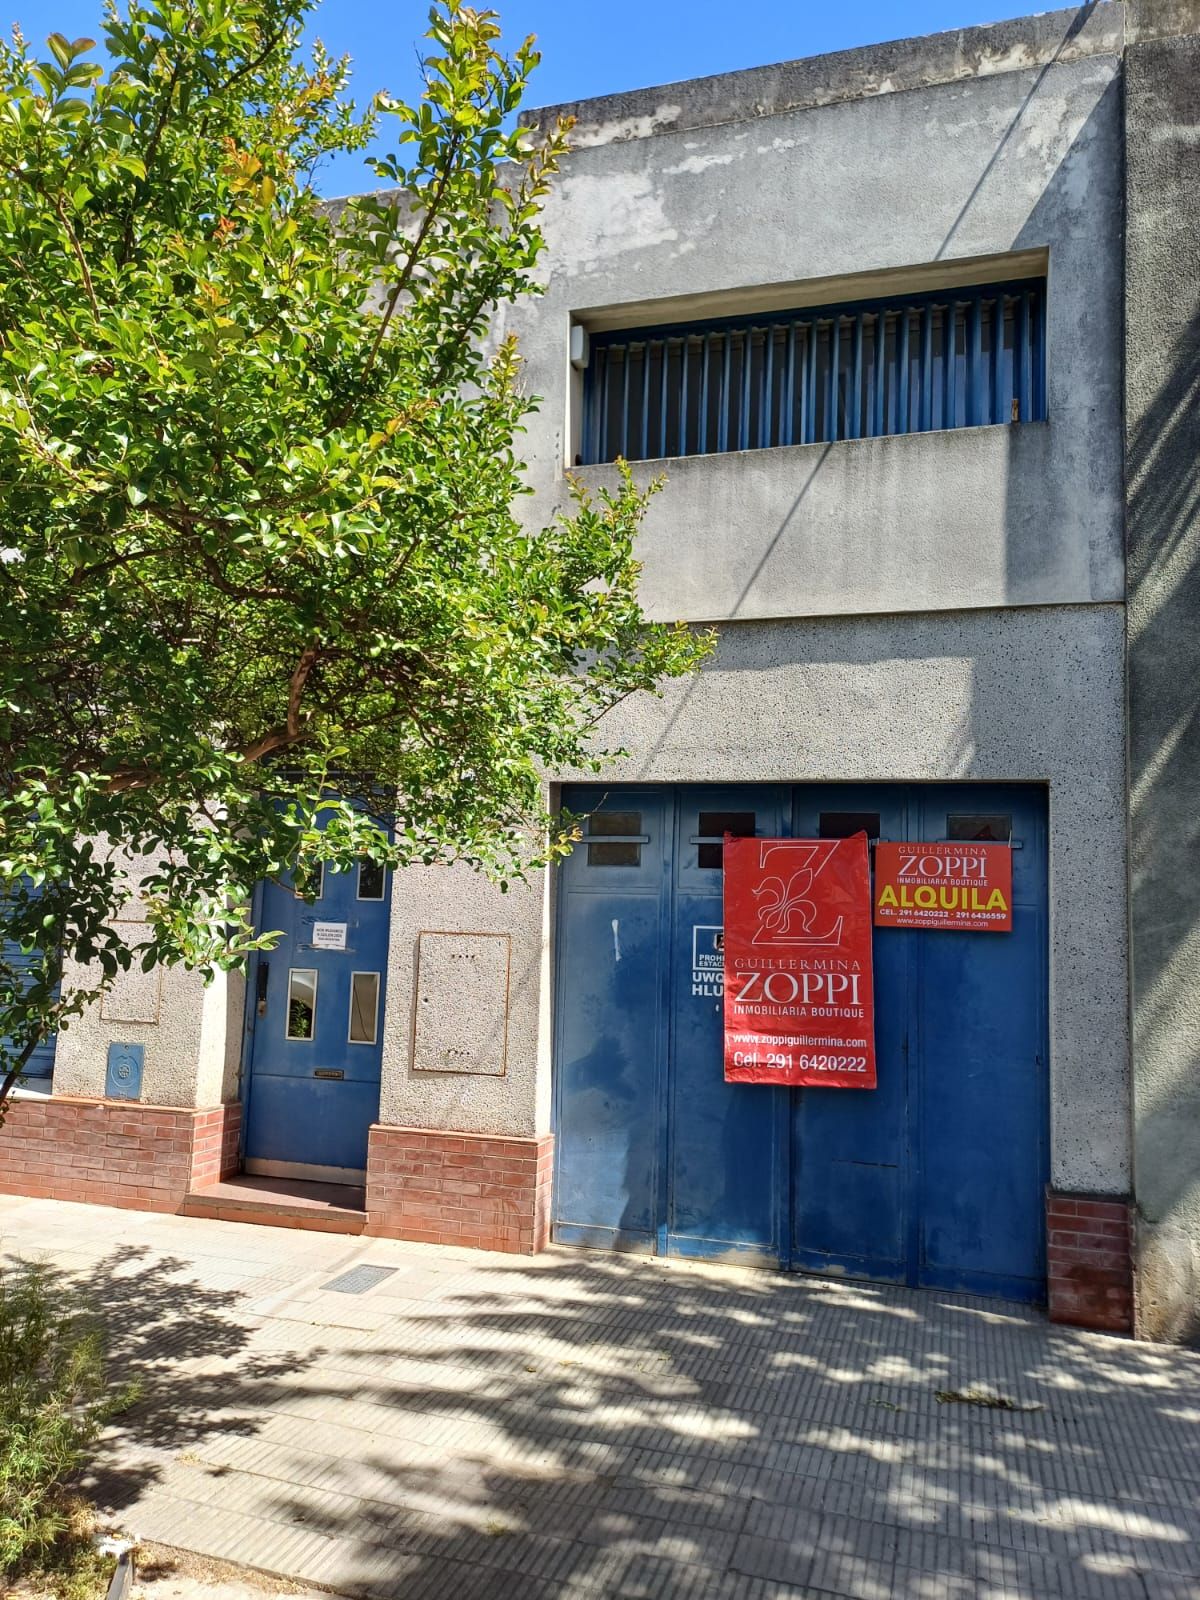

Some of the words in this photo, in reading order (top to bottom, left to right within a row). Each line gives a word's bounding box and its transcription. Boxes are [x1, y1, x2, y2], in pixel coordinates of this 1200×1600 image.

[898, 846, 987, 855] GUILLERMINA
[898, 855, 987, 878] ZOPPI
[897, 877, 948, 885] INMOBILIARIA
[950, 878, 988, 887] BOUTIQUE
[878, 885, 1008, 911] ALQUILA
[914, 910, 949, 918] 6420222
[897, 918, 988, 928] www.zoppiguillermina.com
[699, 954, 724, 962] PROHI
[734, 958, 861, 971] GUILLERMINA
[734, 972, 863, 1005] ZOPPI
[734, 1005, 807, 1017] INMOBILIARIA
[811, 1006, 864, 1018] BOUTIQUE
[733, 1034, 867, 1048] www.zoppiguillermina.com
[733, 1051, 761, 1067] Cel.
[766, 1053, 793, 1069] 291
[800, 1054, 867, 1072] 6420222
